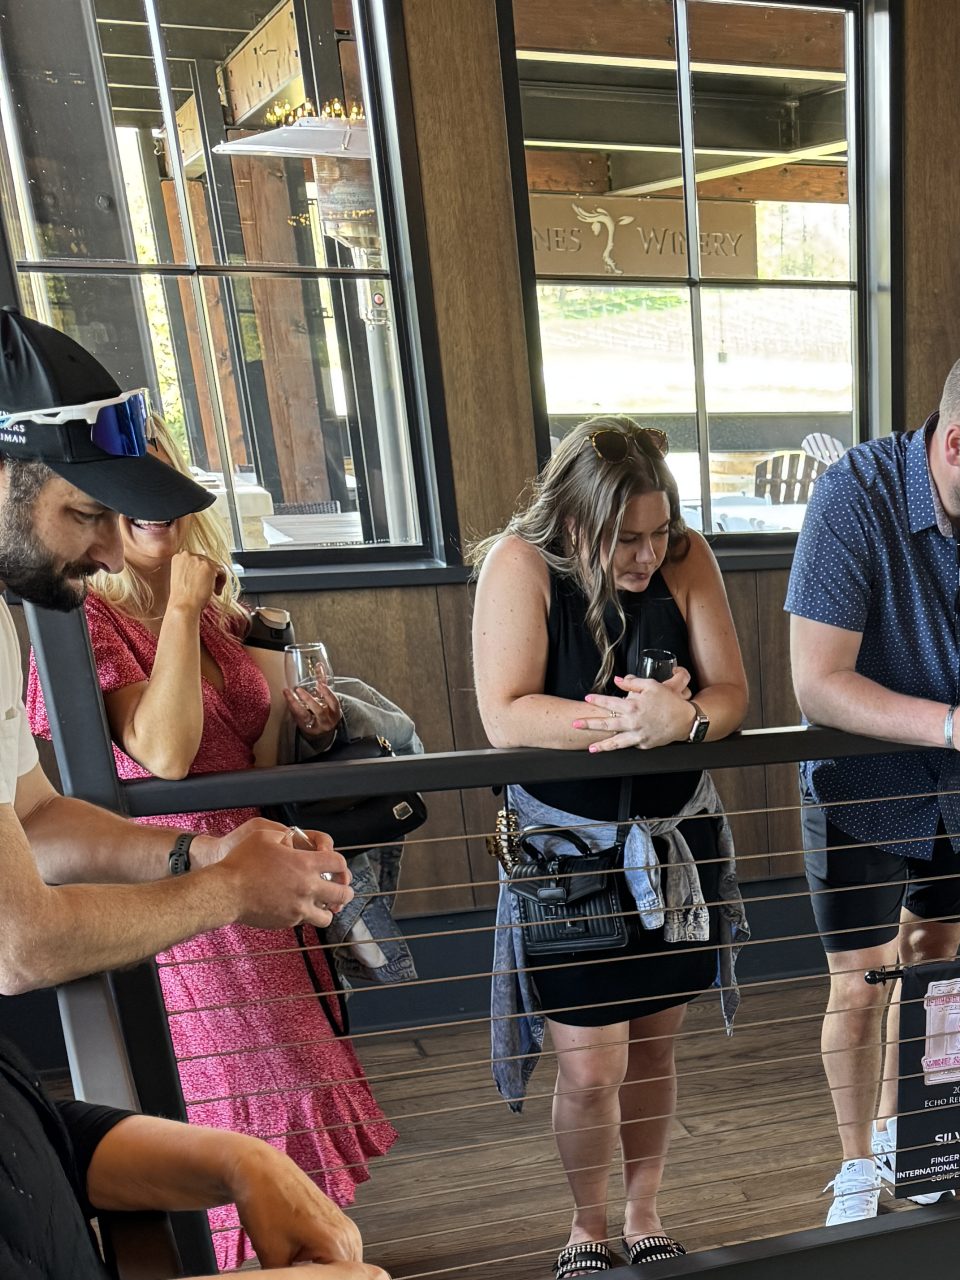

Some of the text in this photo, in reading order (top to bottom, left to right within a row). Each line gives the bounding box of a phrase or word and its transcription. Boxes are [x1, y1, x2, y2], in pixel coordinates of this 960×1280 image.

[925, 1099, 946, 1107] ECHO
[931, 1154, 959, 1164] FINGER
[897, 1164, 959, 1178] INTERNATIONAL
